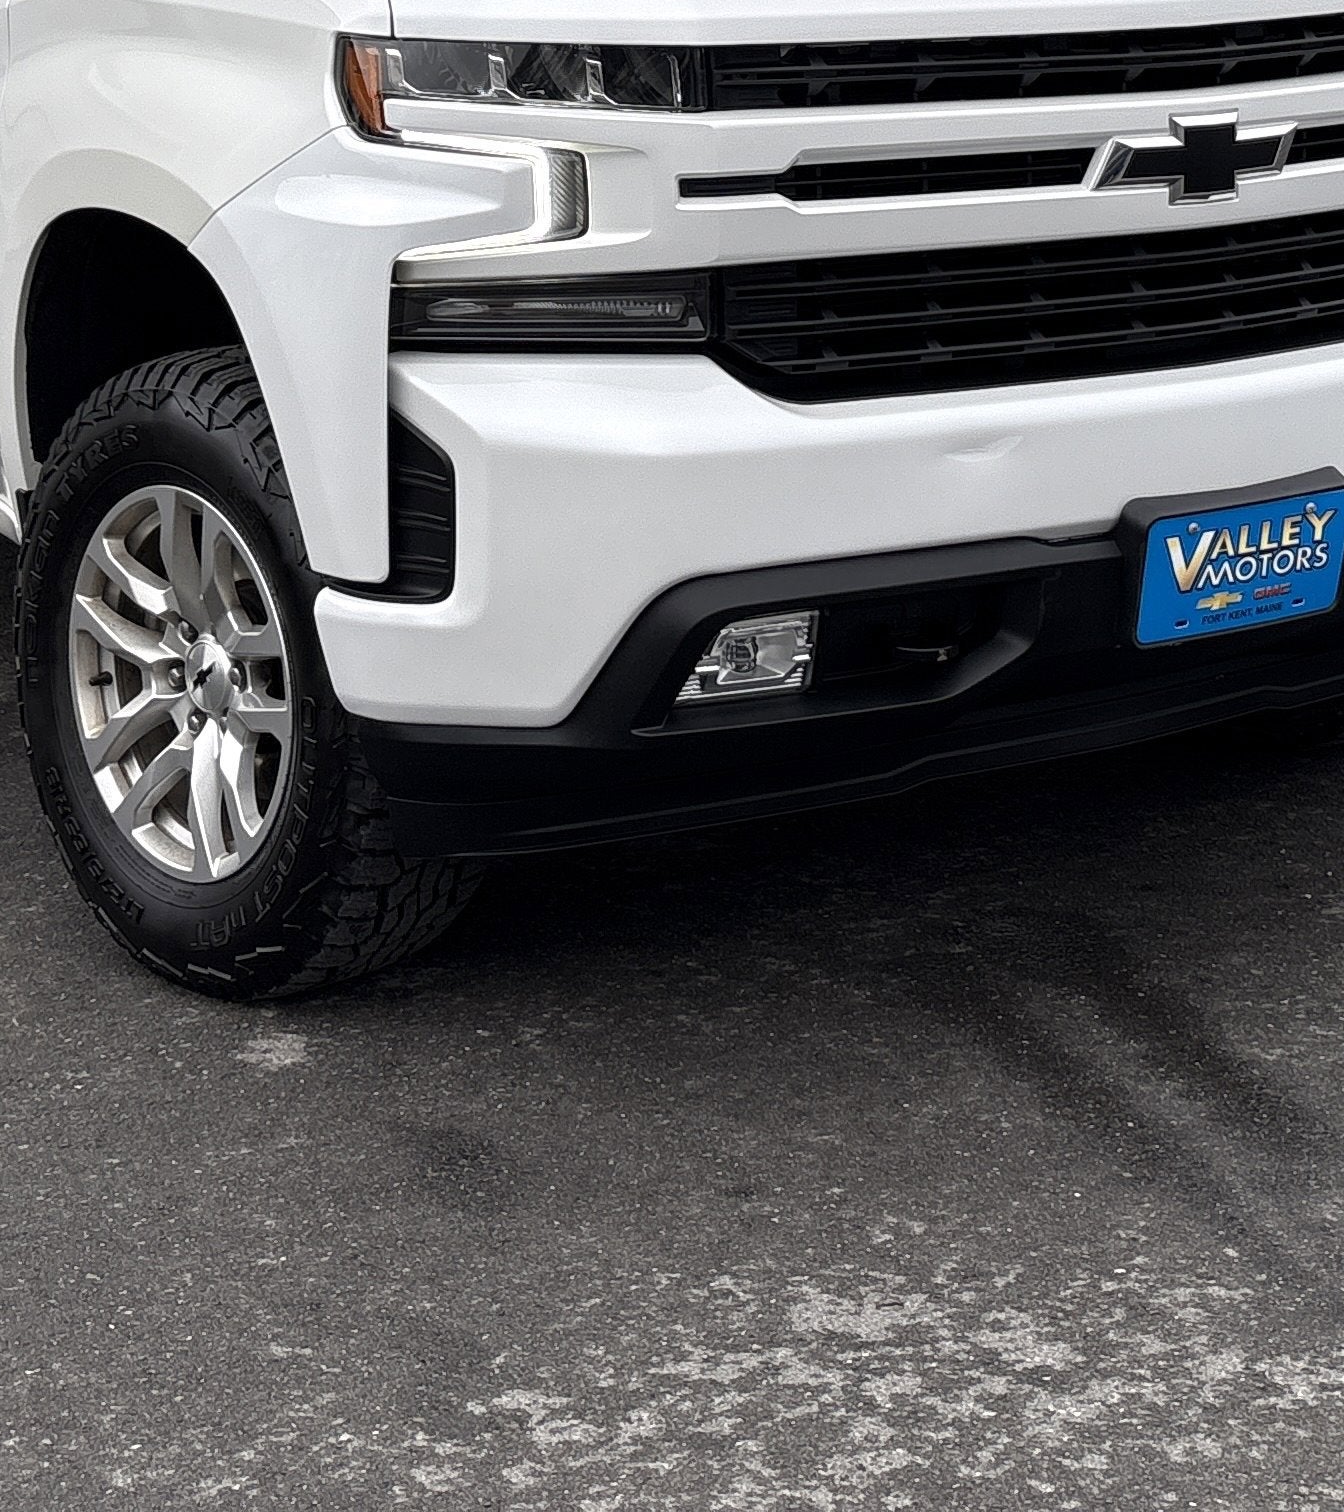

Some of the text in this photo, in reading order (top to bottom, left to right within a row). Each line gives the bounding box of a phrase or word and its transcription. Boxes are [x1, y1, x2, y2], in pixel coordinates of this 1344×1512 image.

[55, 424, 140, 502] TYRES
[1166, 509, 1337, 592] VALLEY MOTORS
[1201, 613, 1226, 625] FORT
[1255, 602, 1283, 615] MAINE
[1253, 582, 1292, 600] GMC
[254, 696, 318, 924] OUTPOST
